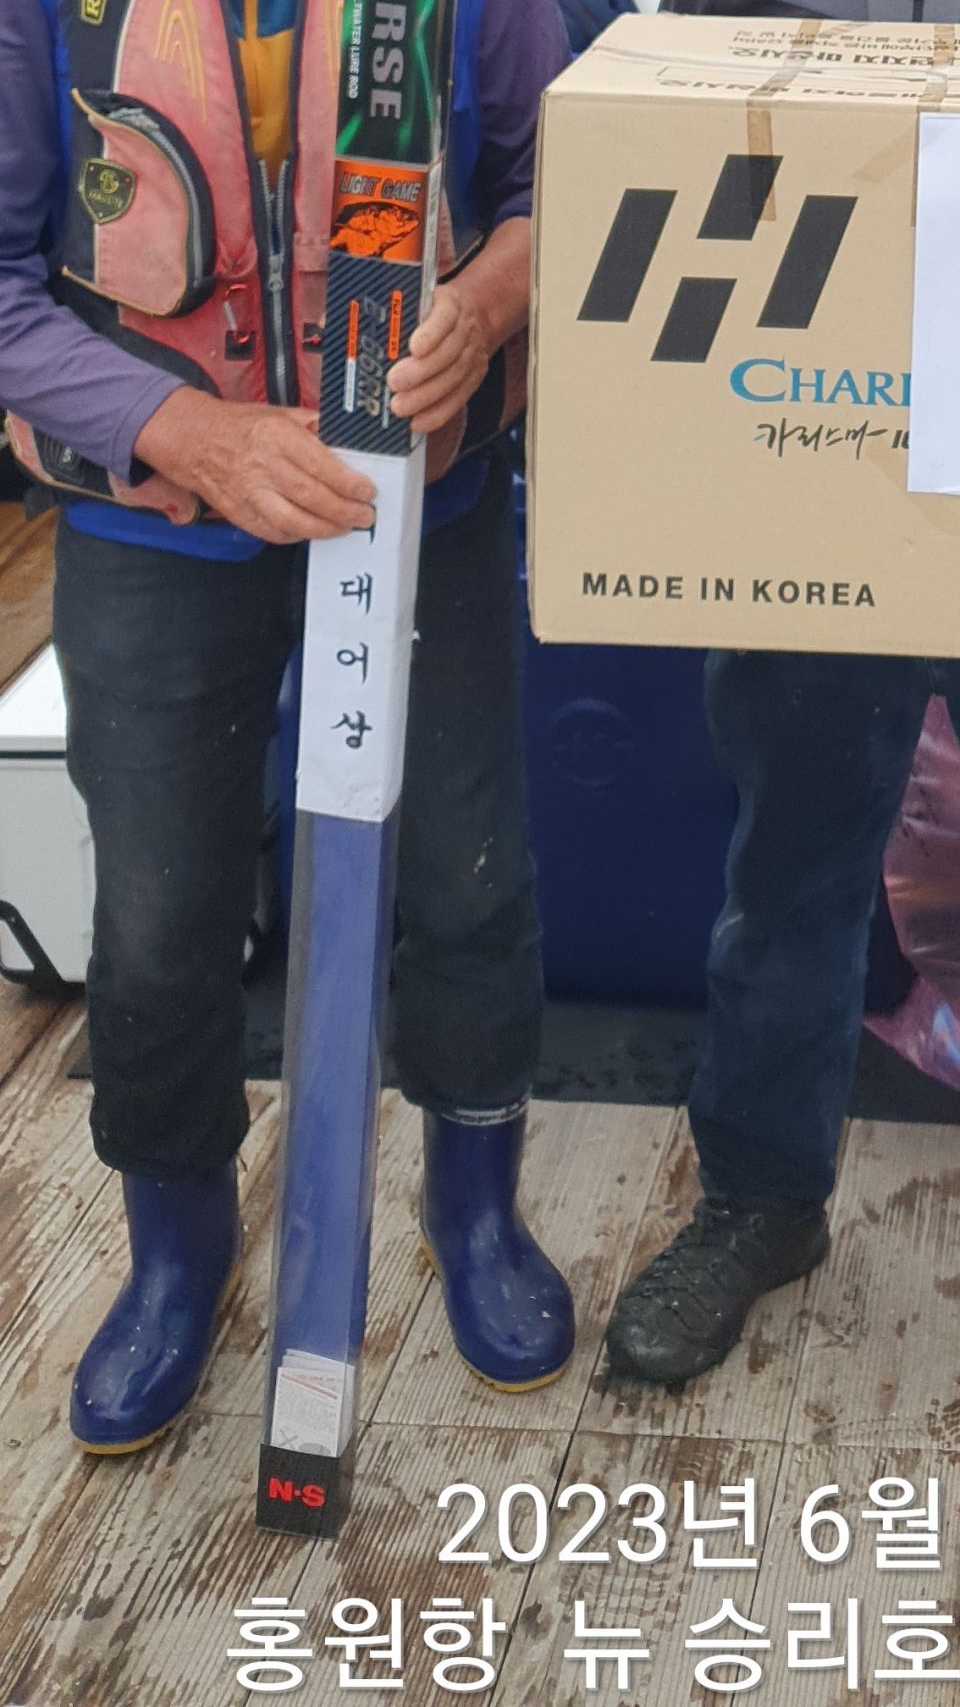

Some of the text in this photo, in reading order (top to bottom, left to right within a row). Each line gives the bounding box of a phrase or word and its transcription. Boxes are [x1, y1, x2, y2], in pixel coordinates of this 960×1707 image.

[339, 170, 422, 203] LIGHT GAME
[582, 571, 877, 609] MADE IN KOREA
